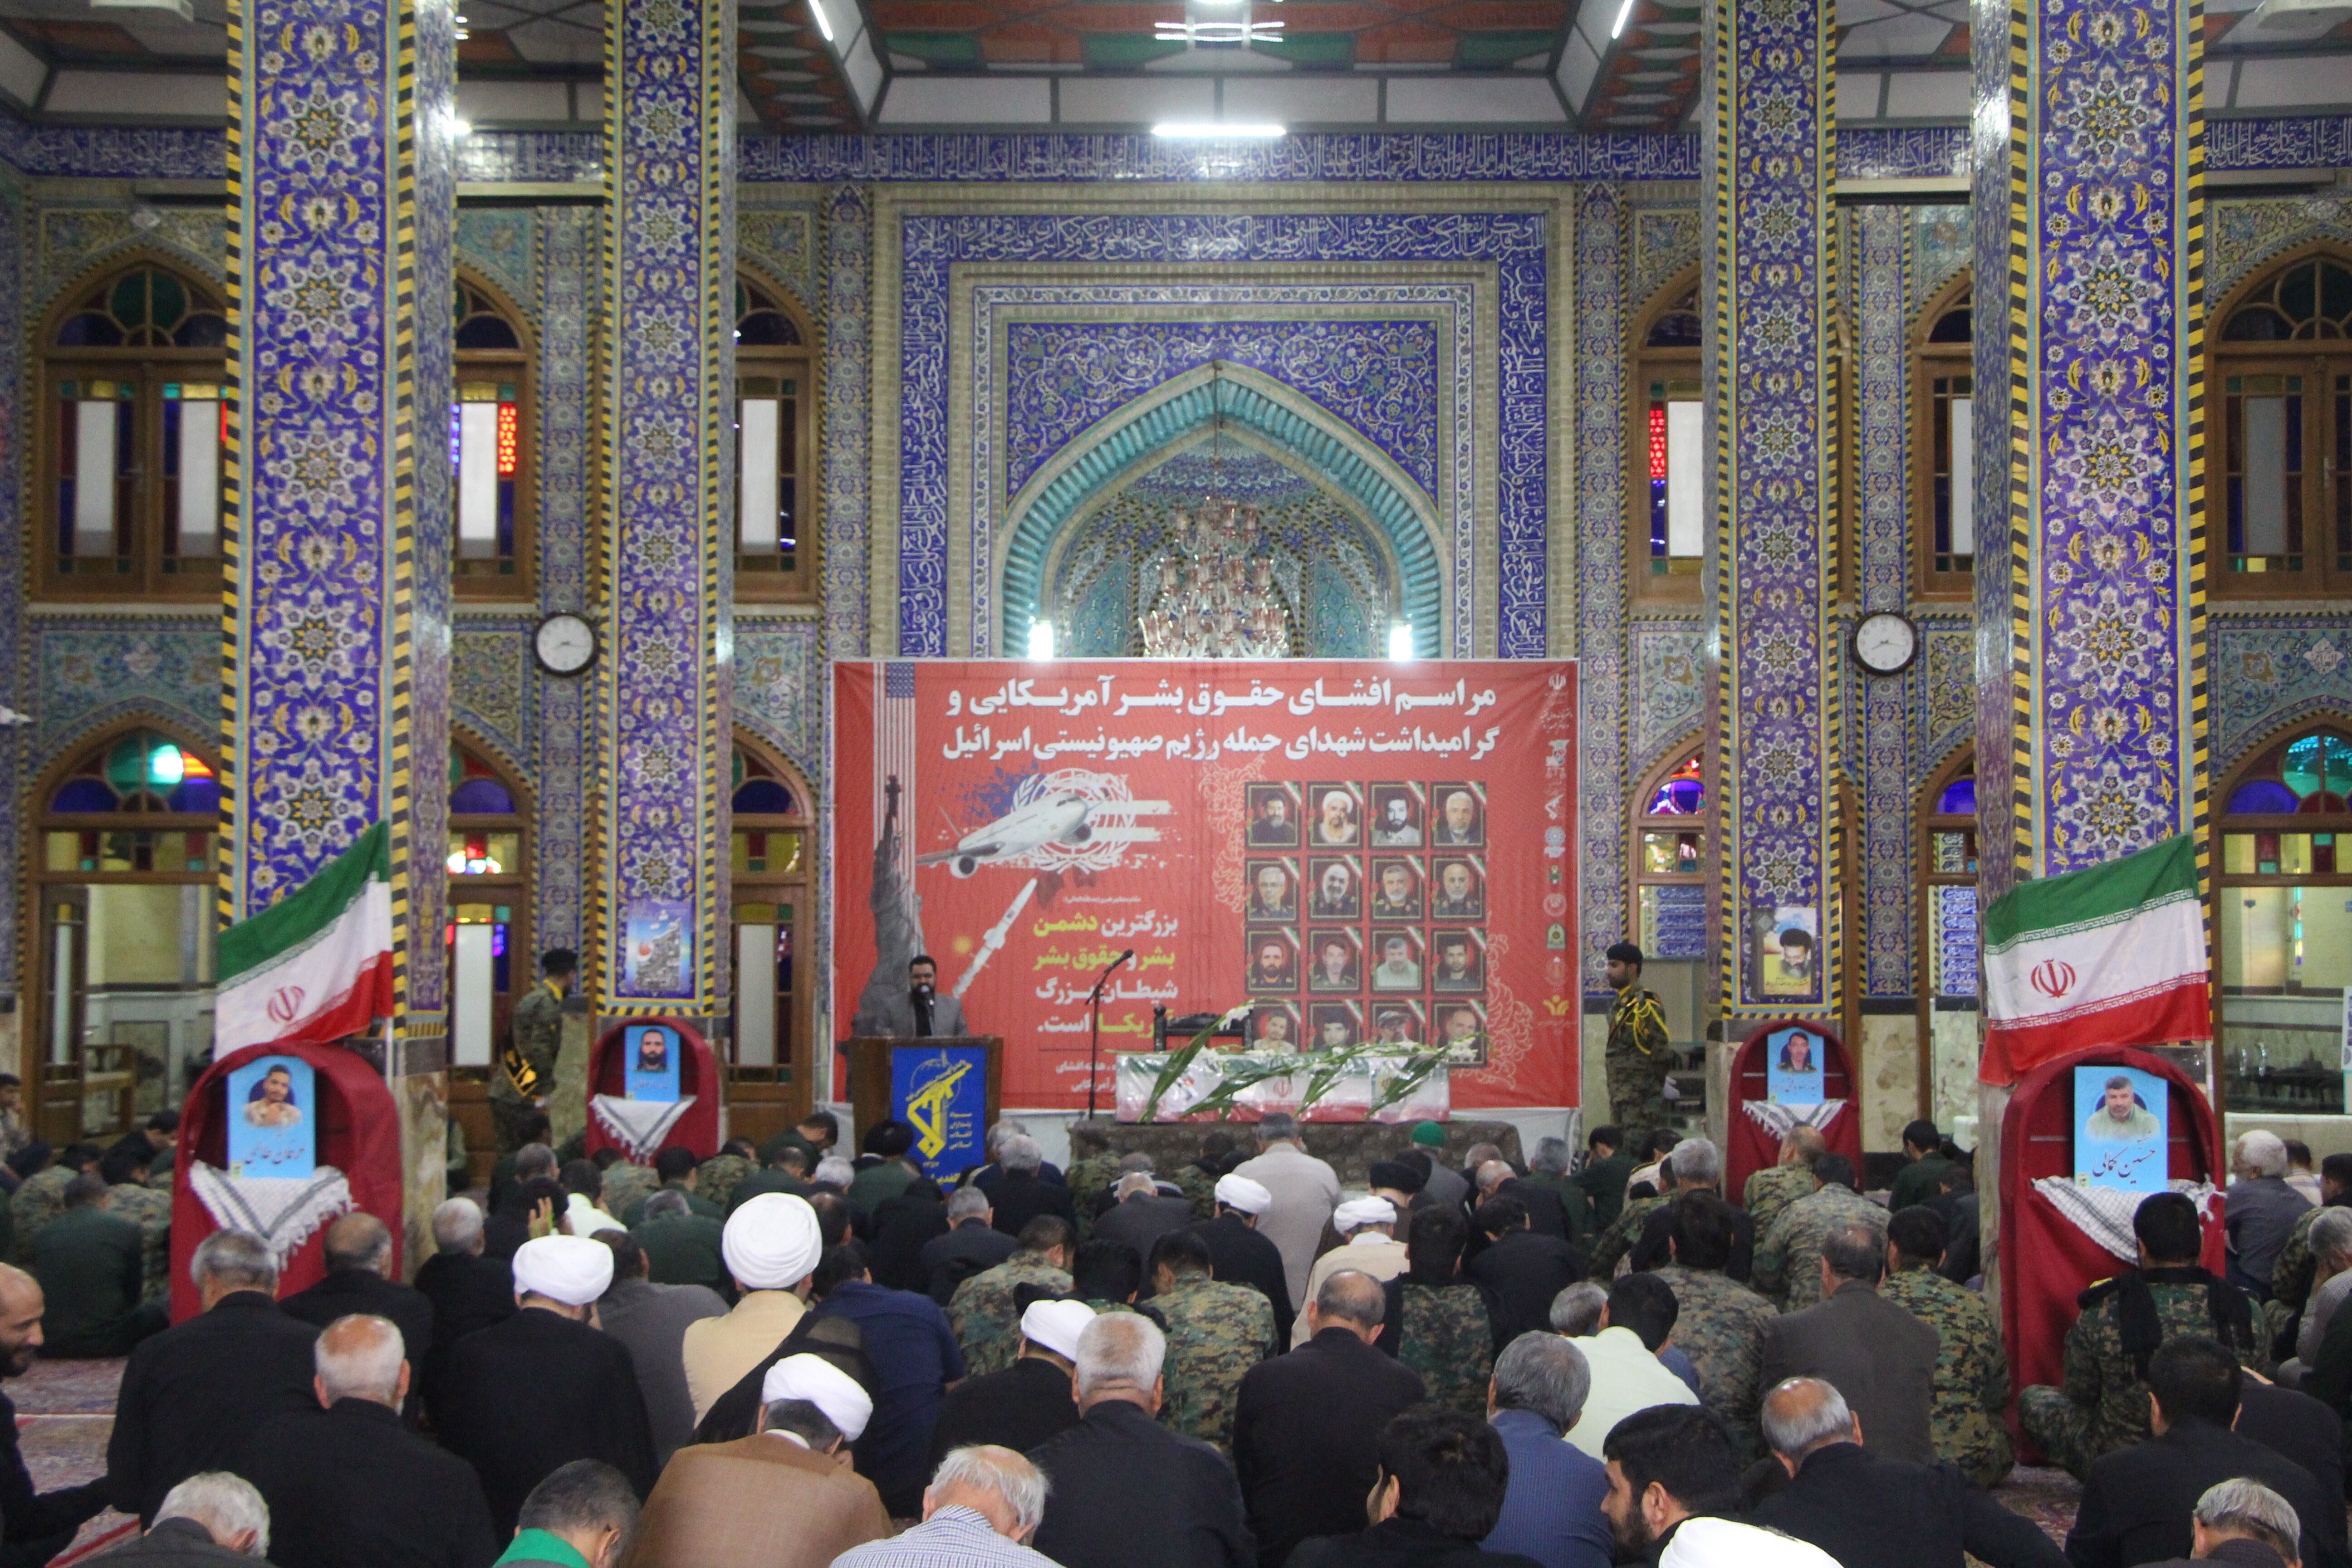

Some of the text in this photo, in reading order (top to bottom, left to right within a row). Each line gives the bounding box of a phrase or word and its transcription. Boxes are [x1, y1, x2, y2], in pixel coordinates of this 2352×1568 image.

[946, 675, 1496, 716] مراسم افشای حقوق بشر آمریکایی و
[942, 723, 1500, 761] گرامیداشت شهدای حمله رژیم صهیونیستی اسرائیل
[1034, 909, 1178, 937] بزرگترین دشمن
[1032, 946, 1070, 971] بشر
[1072, 944, 1123, 971] حقوق
[1138, 946, 1176, 971] بشر
[1100, 979, 1178, 1004] شیطان
[2117, 1149, 2156, 1184] حسین
